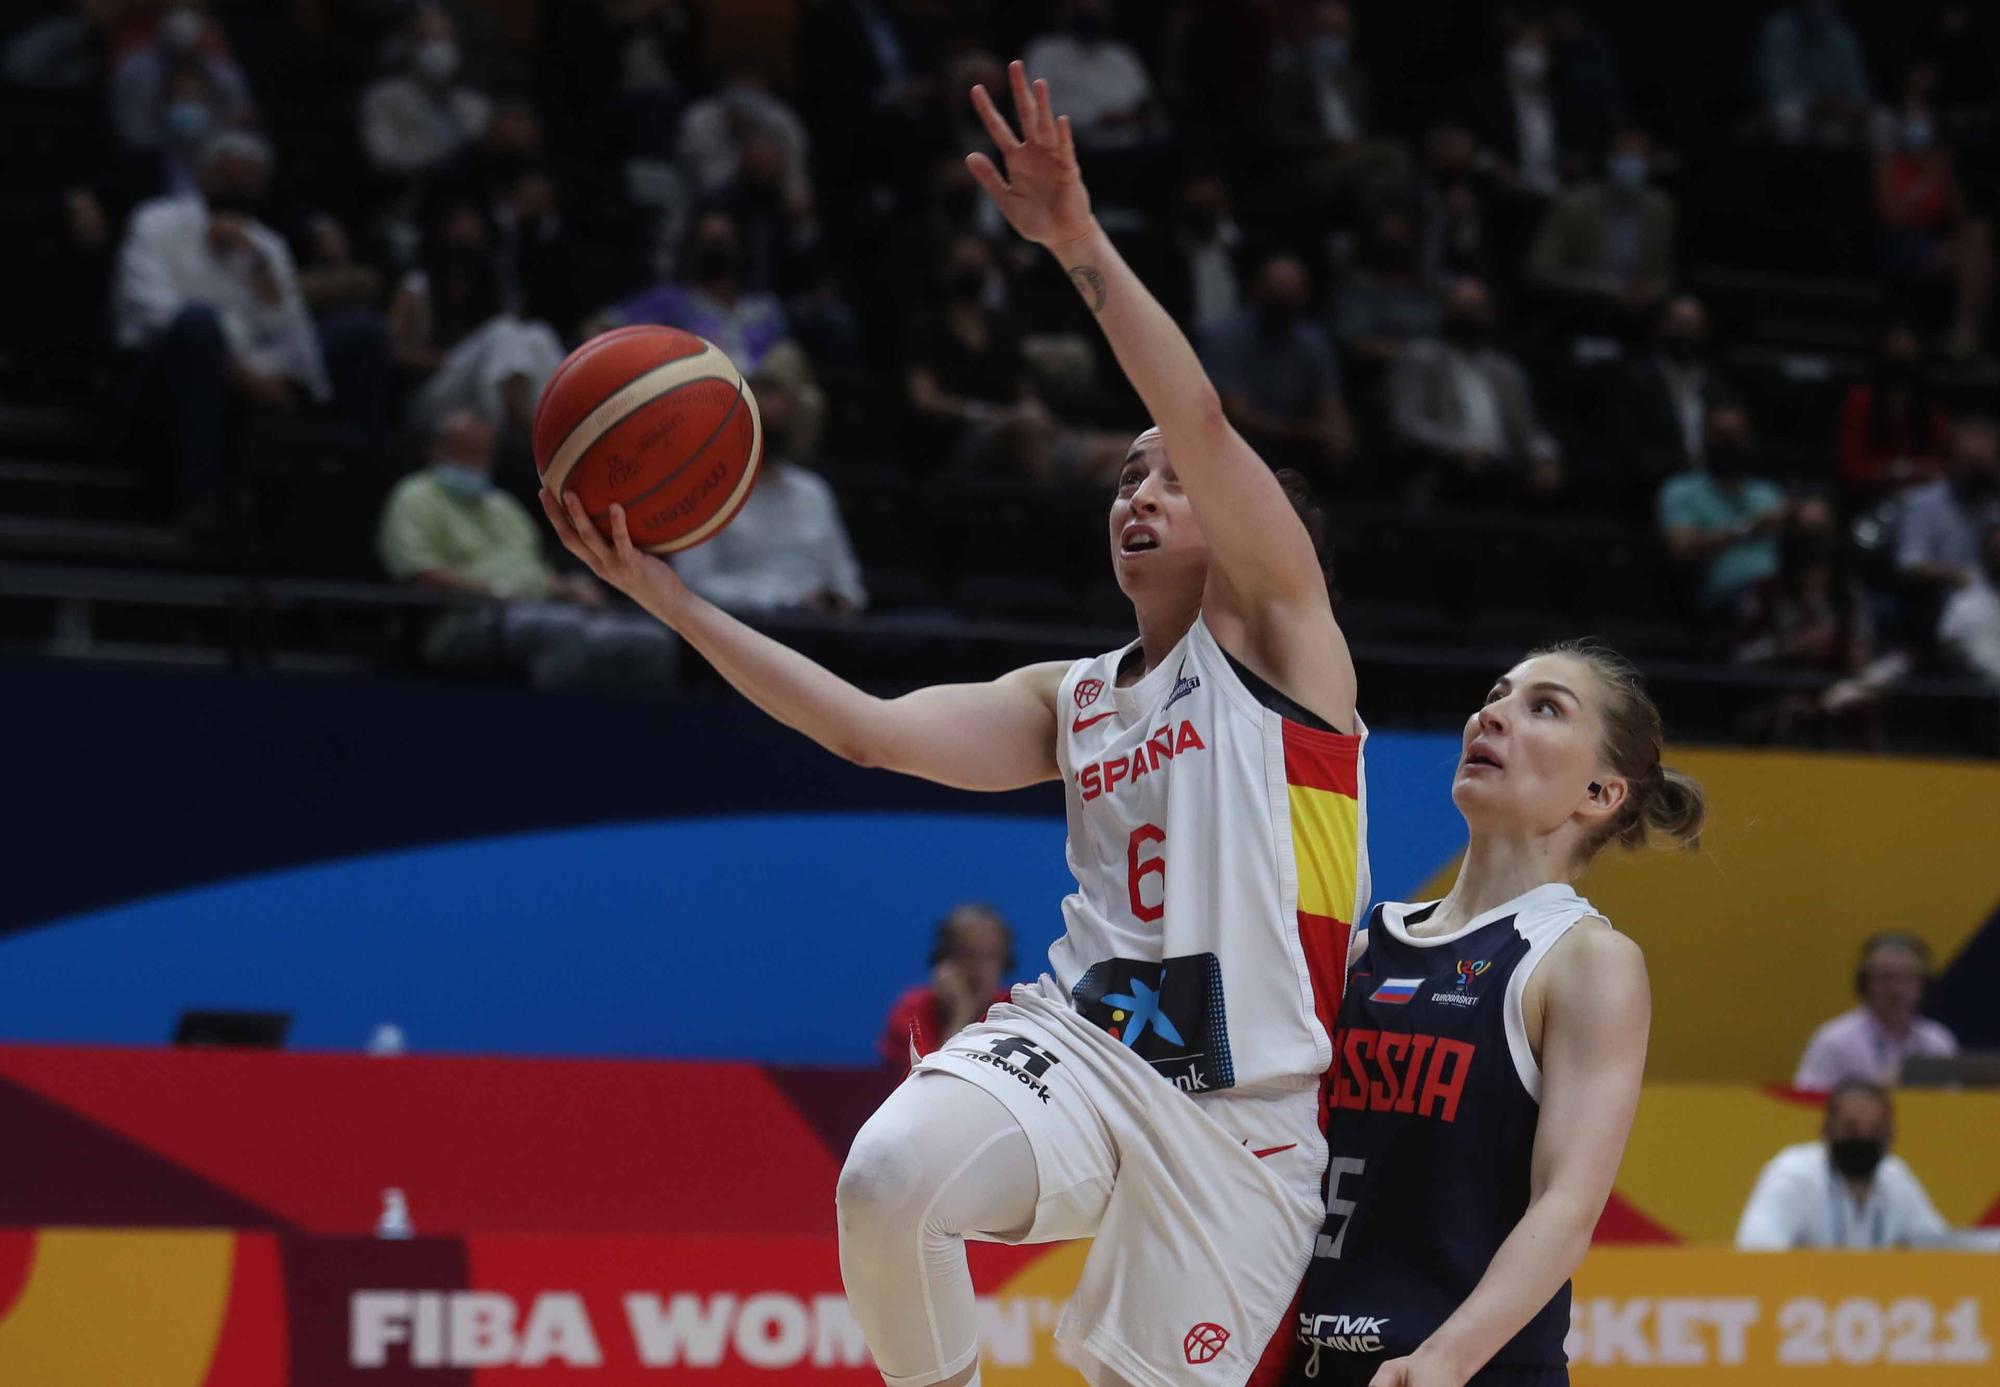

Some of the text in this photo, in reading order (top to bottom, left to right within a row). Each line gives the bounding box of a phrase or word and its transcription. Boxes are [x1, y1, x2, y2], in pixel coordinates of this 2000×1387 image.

[1074, 719, 1206, 801] SPAÑA
[1127, 823, 1167, 922] 6
[965, 1052, 1051, 1105] network
[349, 1290, 602, 1369] FIBA
[1775, 1296, 1992, 1367] 2021
